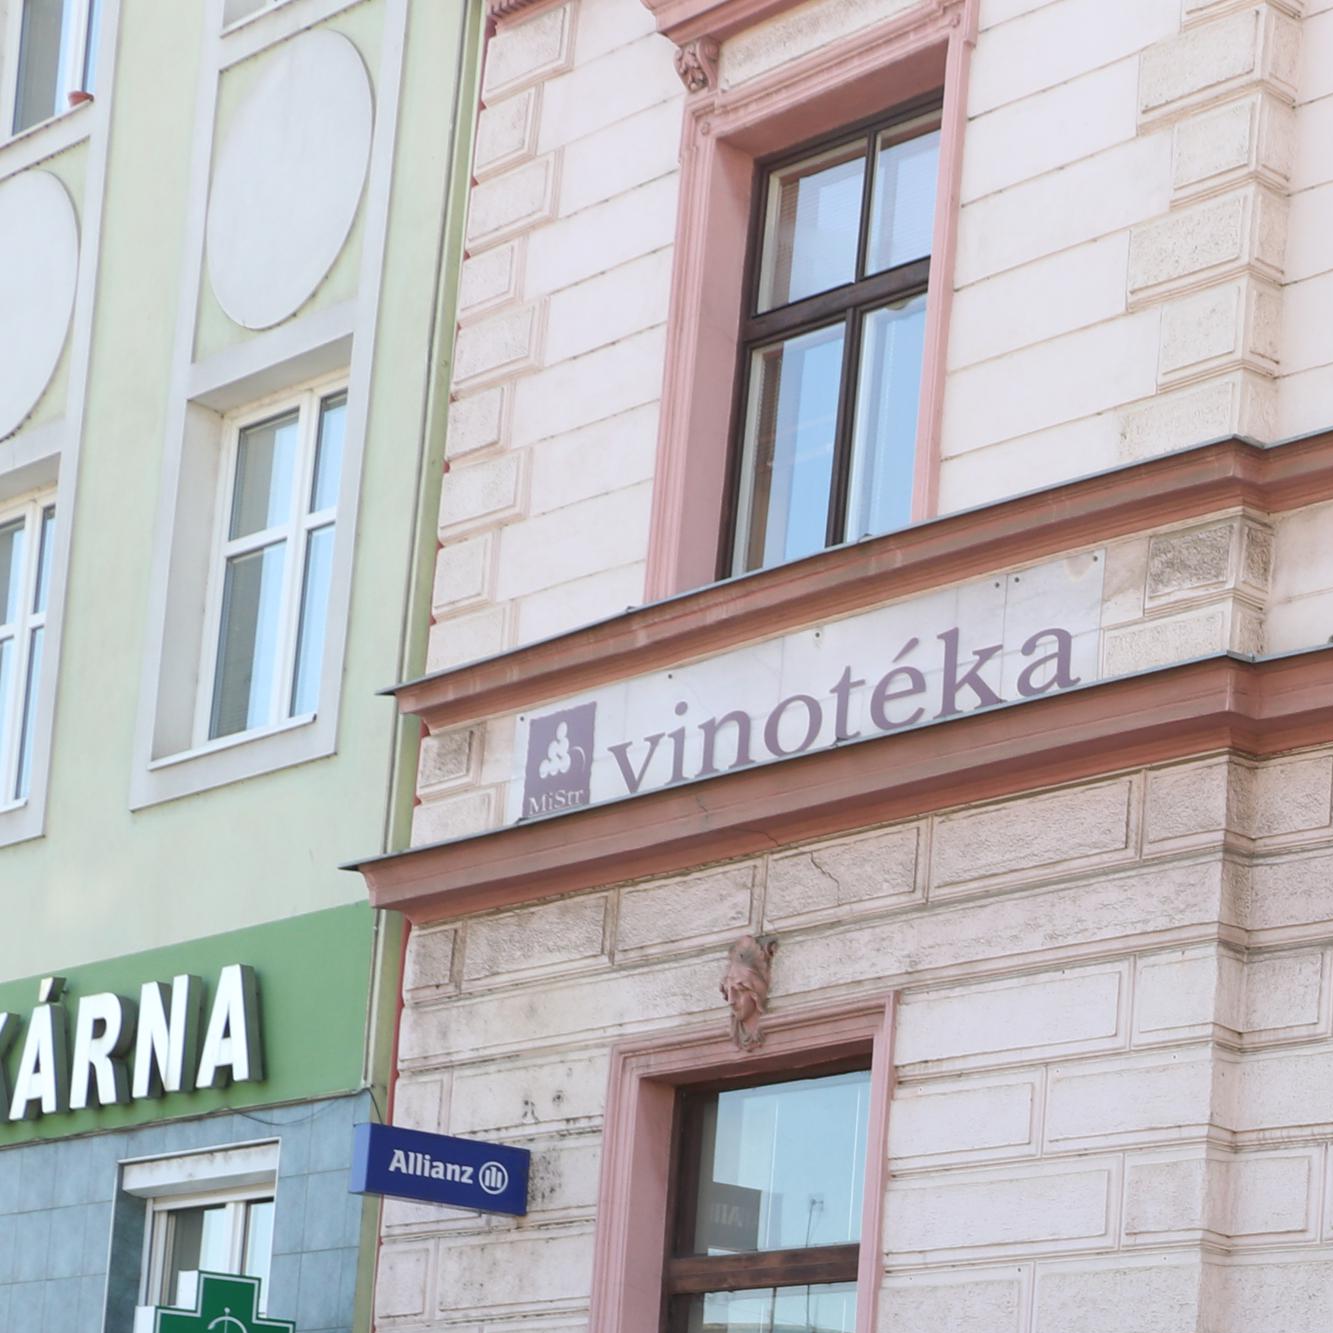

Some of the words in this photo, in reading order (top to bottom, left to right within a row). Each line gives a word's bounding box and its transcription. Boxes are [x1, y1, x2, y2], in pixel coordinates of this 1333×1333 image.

[607, 626, 1081, 795] vinotéka
[528, 788, 585, 816] MiStr
[0, 963, 256, 1122] ÁRNA
[388, 1148, 475, 1185] Allianz
